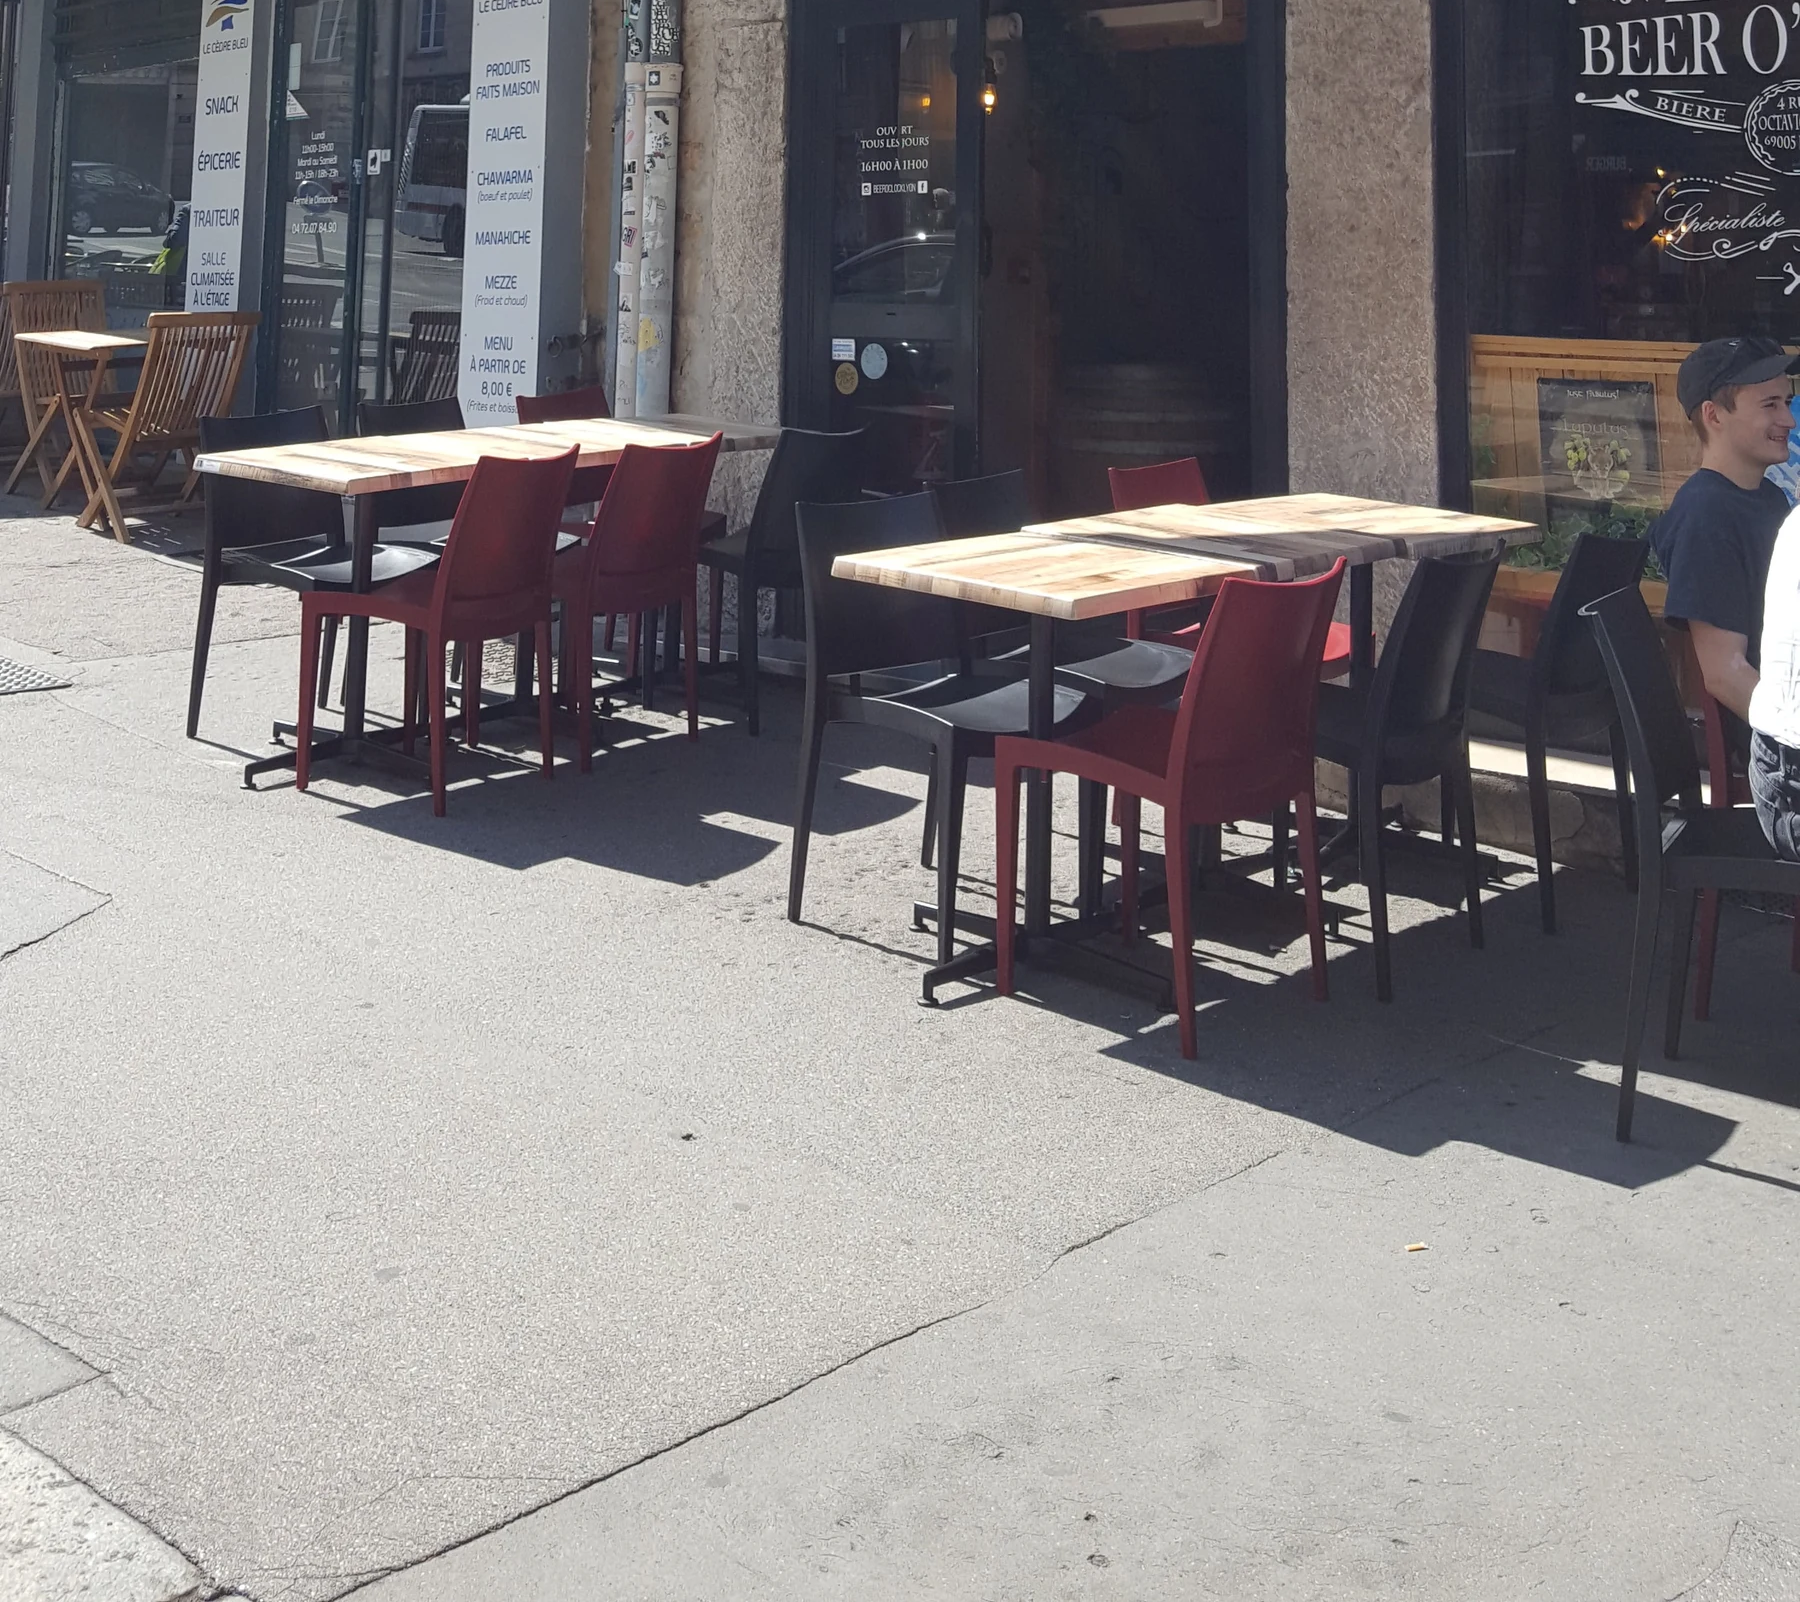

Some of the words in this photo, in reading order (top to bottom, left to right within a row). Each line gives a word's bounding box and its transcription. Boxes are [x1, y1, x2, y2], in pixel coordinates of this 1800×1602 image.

[479, 0, 490, 14] LE
[203, 43, 211, 54] LE
[211, 40, 232, 53] CÈDRE
[232, 37, 249, 50] BLEU
[1579, 11, 1728, 76] BEER
[486, 59, 531, 78] PRODUITS
[476, 84, 500, 100] FAITS
[502, 80, 541, 97] MAISON
[205, 95, 239, 115] SNACK
[1655, 96, 1727, 122] BIERE
[1777, 96, 1785, 110] 4
[1758, 114, 1800, 131] OCTAVI
[311, 131, 326, 140] Lundi
[486, 126, 527, 142] FALAFEL
[860, 139, 885, 149] TOUS
[886, 139, 900, 148] LES
[902, 136, 929, 149] JOURS
[1764, 135, 1796, 150] 69005
[198, 150, 241, 171] ÉPICERIE
[297, 158, 311, 167] Mardi
[319, 155, 338, 166] Samedi
[861, 160, 892, 172] 16H00
[893, 158, 901, 170] À
[903, 159, 928, 170] 1H00
[477, 170, 533, 186] CHAWARMA
[314, 195, 338, 204] Dimanche
[500, 192, 507, 201] et
[508, 188, 533, 202] poulet)
[193, 208, 240, 227] TRAITEUR
[1658, 203, 1785, 244] Spécialiste
[475, 230, 531, 245] MANAKICHE
[201, 252, 226, 266] SALLE
[191, 269, 235, 286] CLIMATISÉE
[484, 276, 517, 289] MEZZE
[193, 289, 200, 306] À
[200, 290, 230, 307] L'ÉTAGE
[475, 294, 494, 308] (Froid
[495, 296, 503, 306] et
[504, 295, 528, 308] chaud)
[484, 336, 513, 351] MENU
[470, 355, 477, 372] À
[478, 358, 510, 374] PARTIR
[512, 360, 527, 374] DE
[481, 381, 504, 398] 8,00
[506, 382, 512, 397] €
[466, 399, 488, 413] (Frites
[489, 403, 496, 412] et
